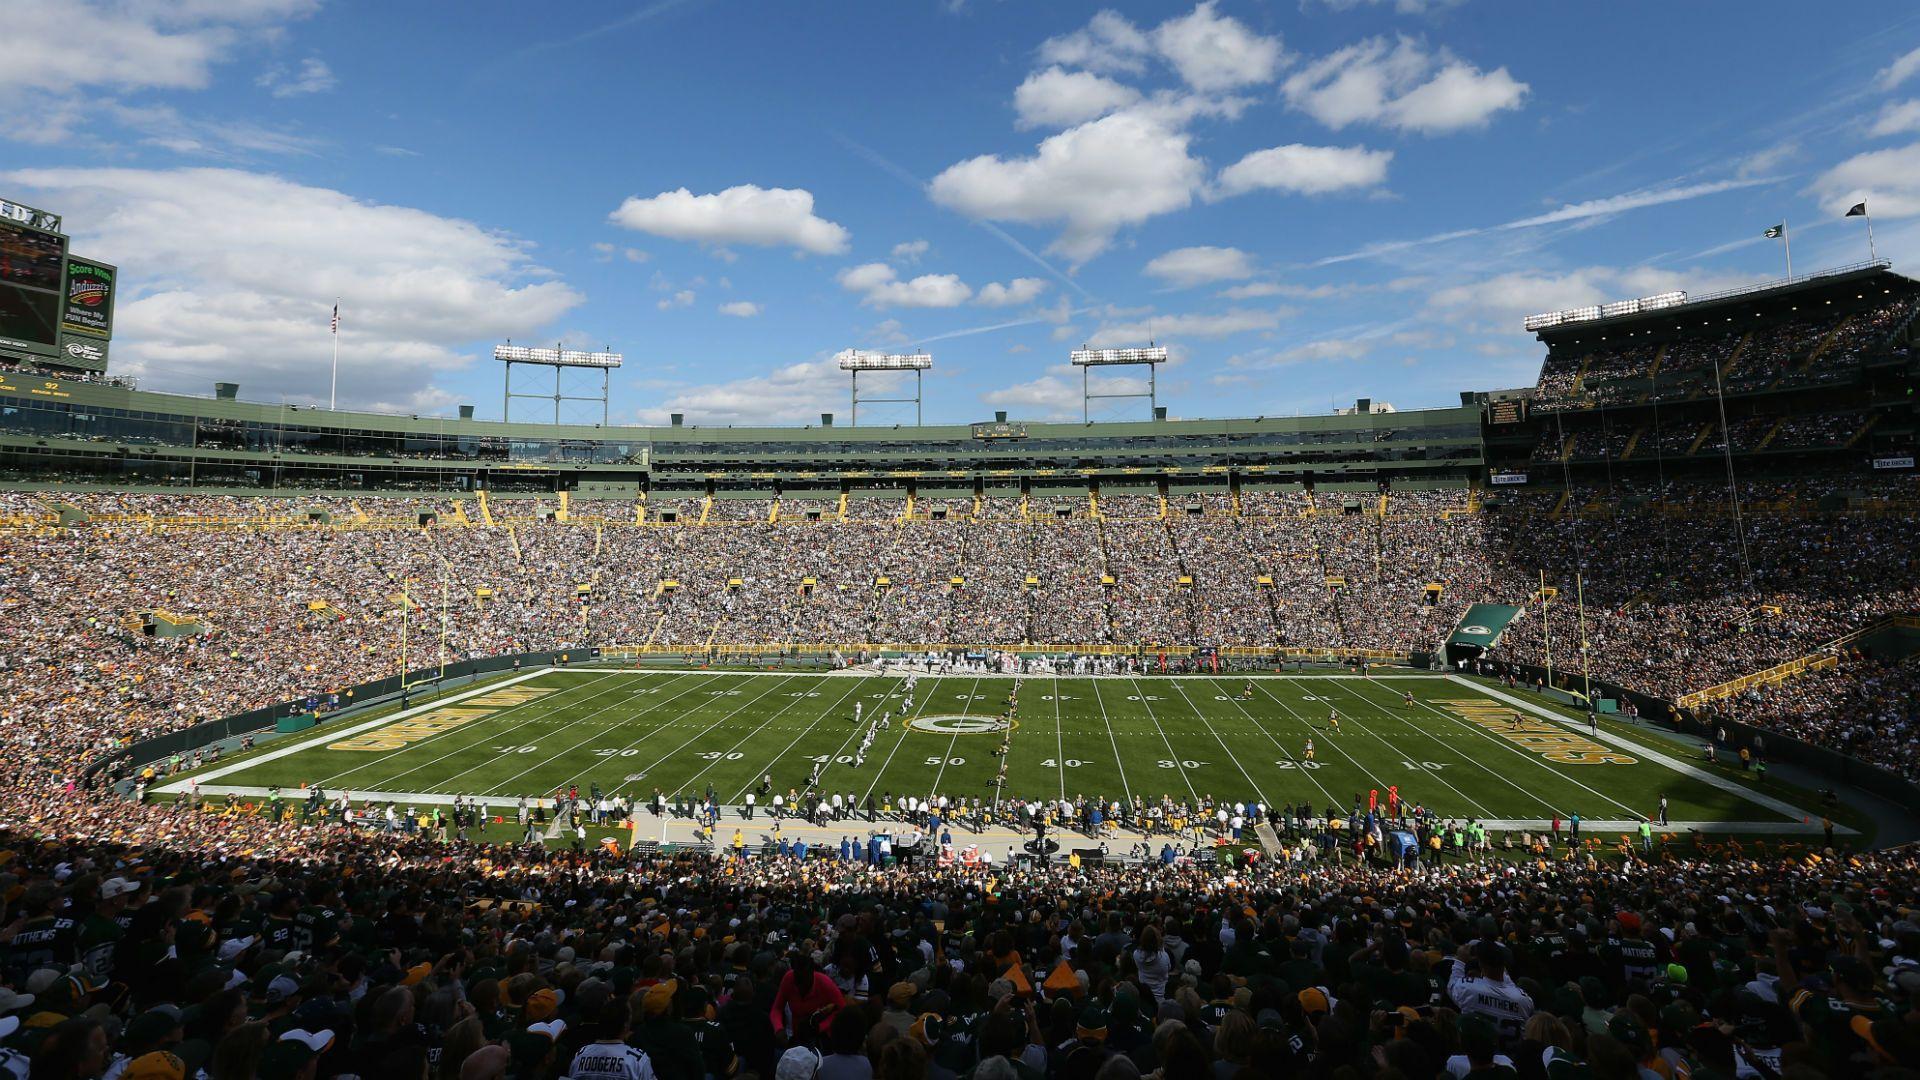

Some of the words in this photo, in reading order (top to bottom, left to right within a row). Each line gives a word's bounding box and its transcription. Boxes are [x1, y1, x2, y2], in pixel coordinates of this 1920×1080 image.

[69, 264, 93, 275] Score
[65, 313, 80, 322] FUN
[44, 382, 59, 390] 92
[902, 713, 1020, 735] G
[498, 745, 538, 754] 10
[595, 748, 639, 757] 20
[702, 751, 744, 760] 30
[811, 754, 854, 764] 40
[924, 756, 966, 766] 50
[1040, 758, 1082, 768] 40
[1156, 759, 1200, 769] 30
[1401, 761, 1443, 770] 10
[10, 928, 57, 946] ATTHEWS
[273, 927, 289, 943] 92
[1621, 946, 1656, 959] MATTHEWS
[1478, 993, 1520, 1014] MATTHEWS
[578, 1055, 625, 1073] RODGERS
